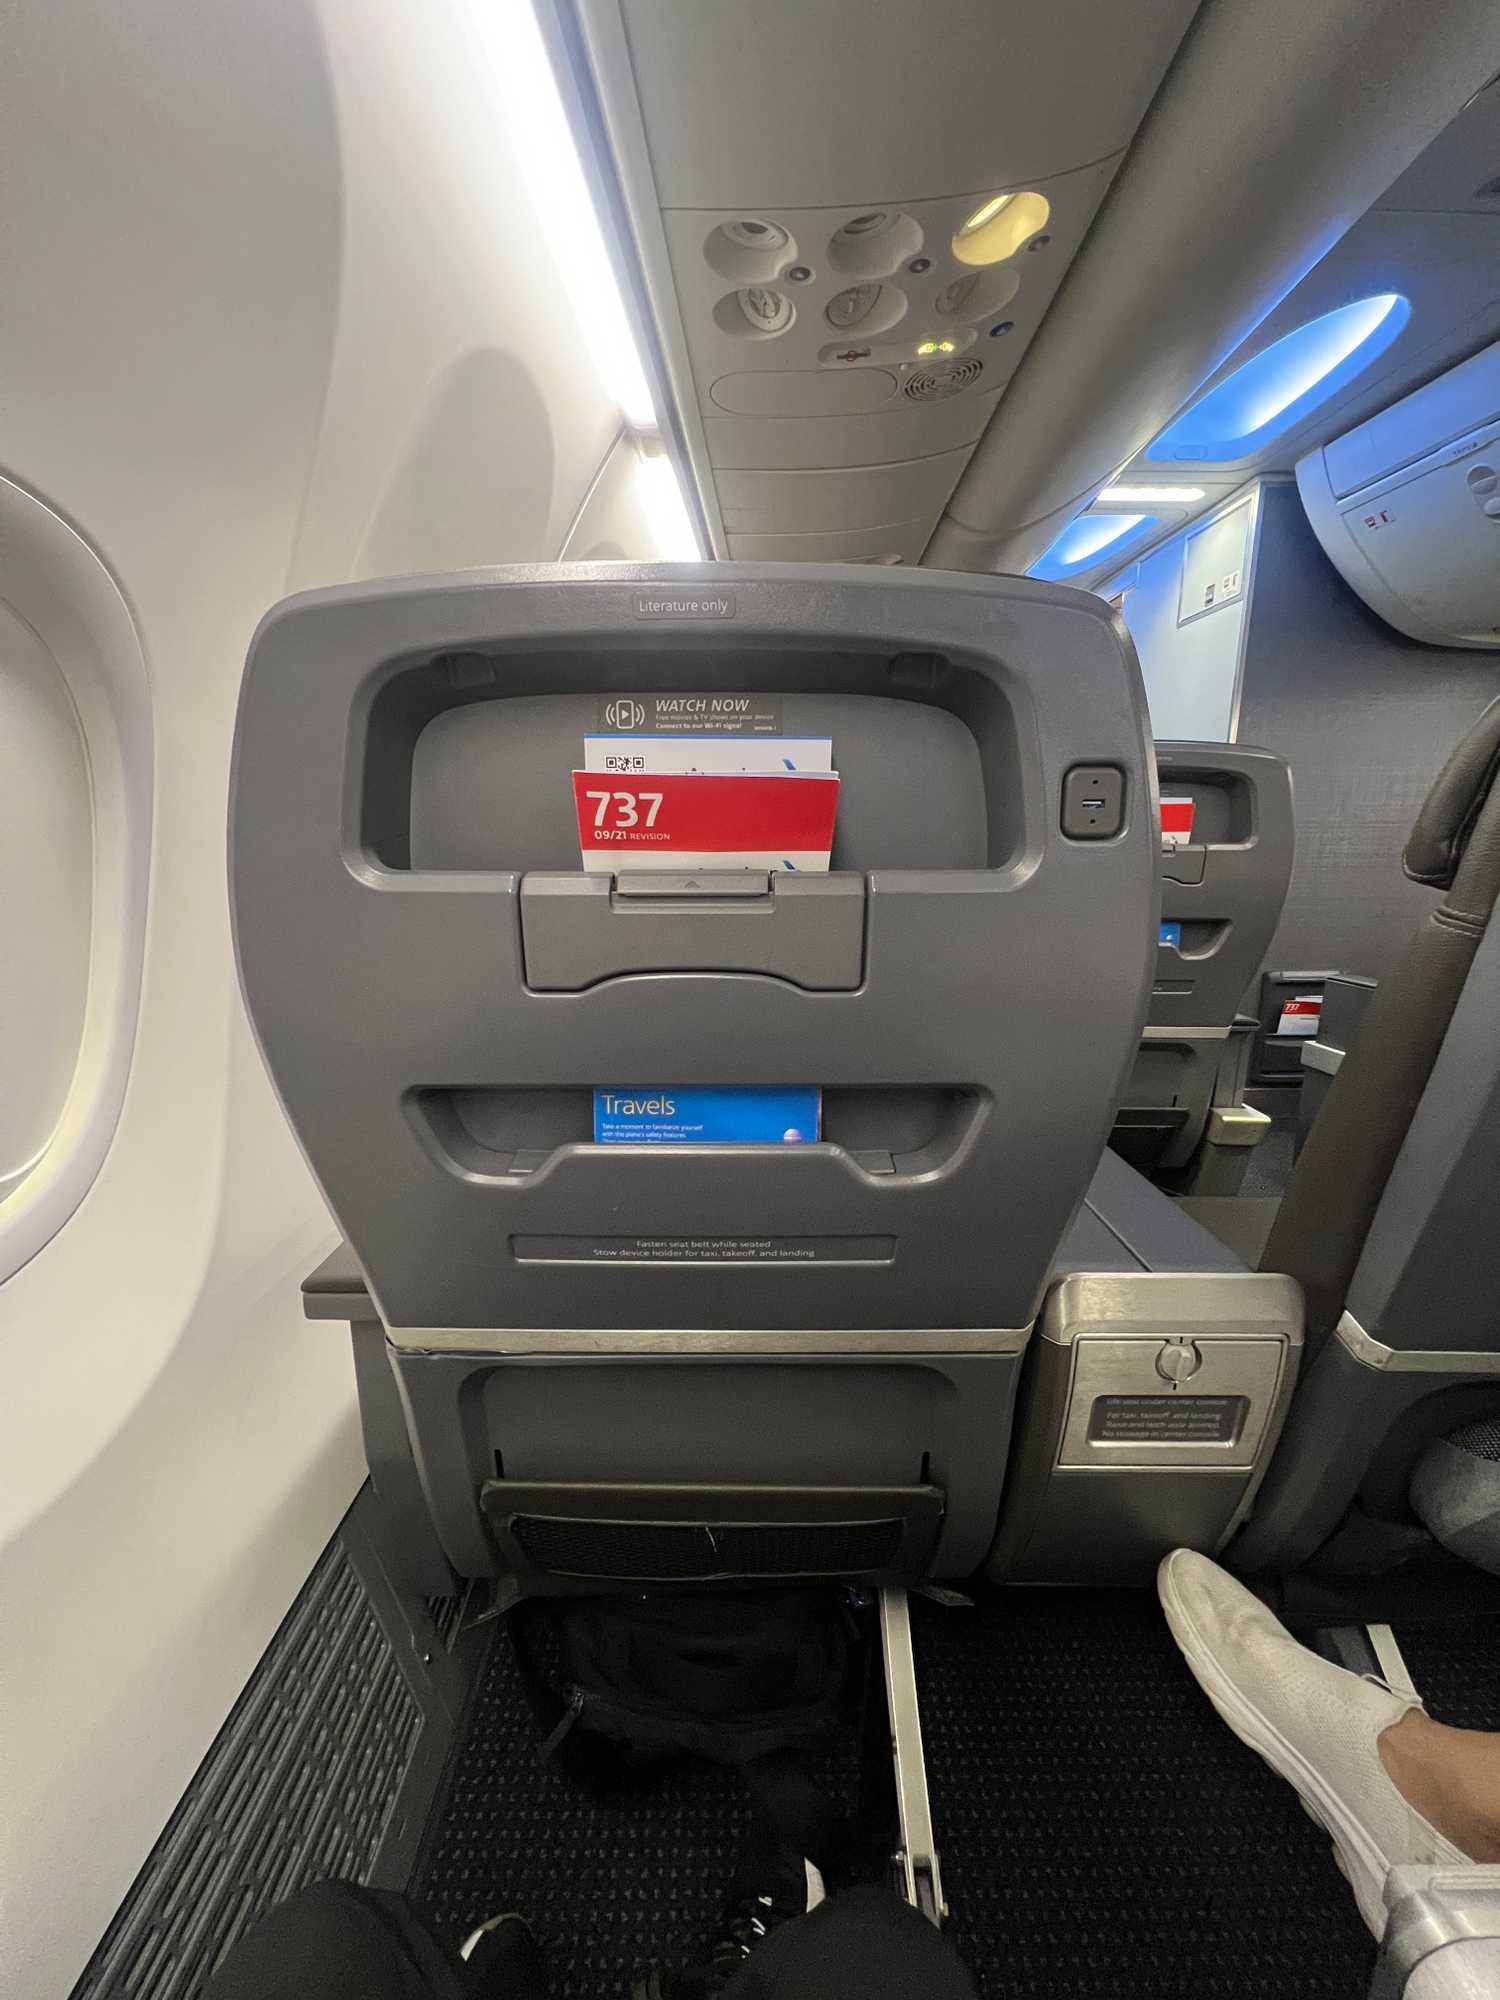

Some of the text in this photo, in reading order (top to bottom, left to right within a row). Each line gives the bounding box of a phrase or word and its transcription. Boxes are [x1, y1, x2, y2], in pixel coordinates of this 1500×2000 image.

[639, 599, 728, 614] Literature only
[655, 699, 750, 712] WATCH NOW
[723, 722, 742, 730] signal
[586, 790, 664, 827] 737
[594, 830, 671, 841] 09/21 REVISION
[1284, 1003, 1301, 1011] 737
[602, 1094, 676, 1116] Travels
[636, 1240, 668, 1248] Fasten
[690, 1240, 710, 1248] belt
[711, 1240, 738, 1248] while
[739, 1240, 771, 1248] seated
[652, 1249, 682, 1257] holder
[780, 1250, 815, 1258] landing
